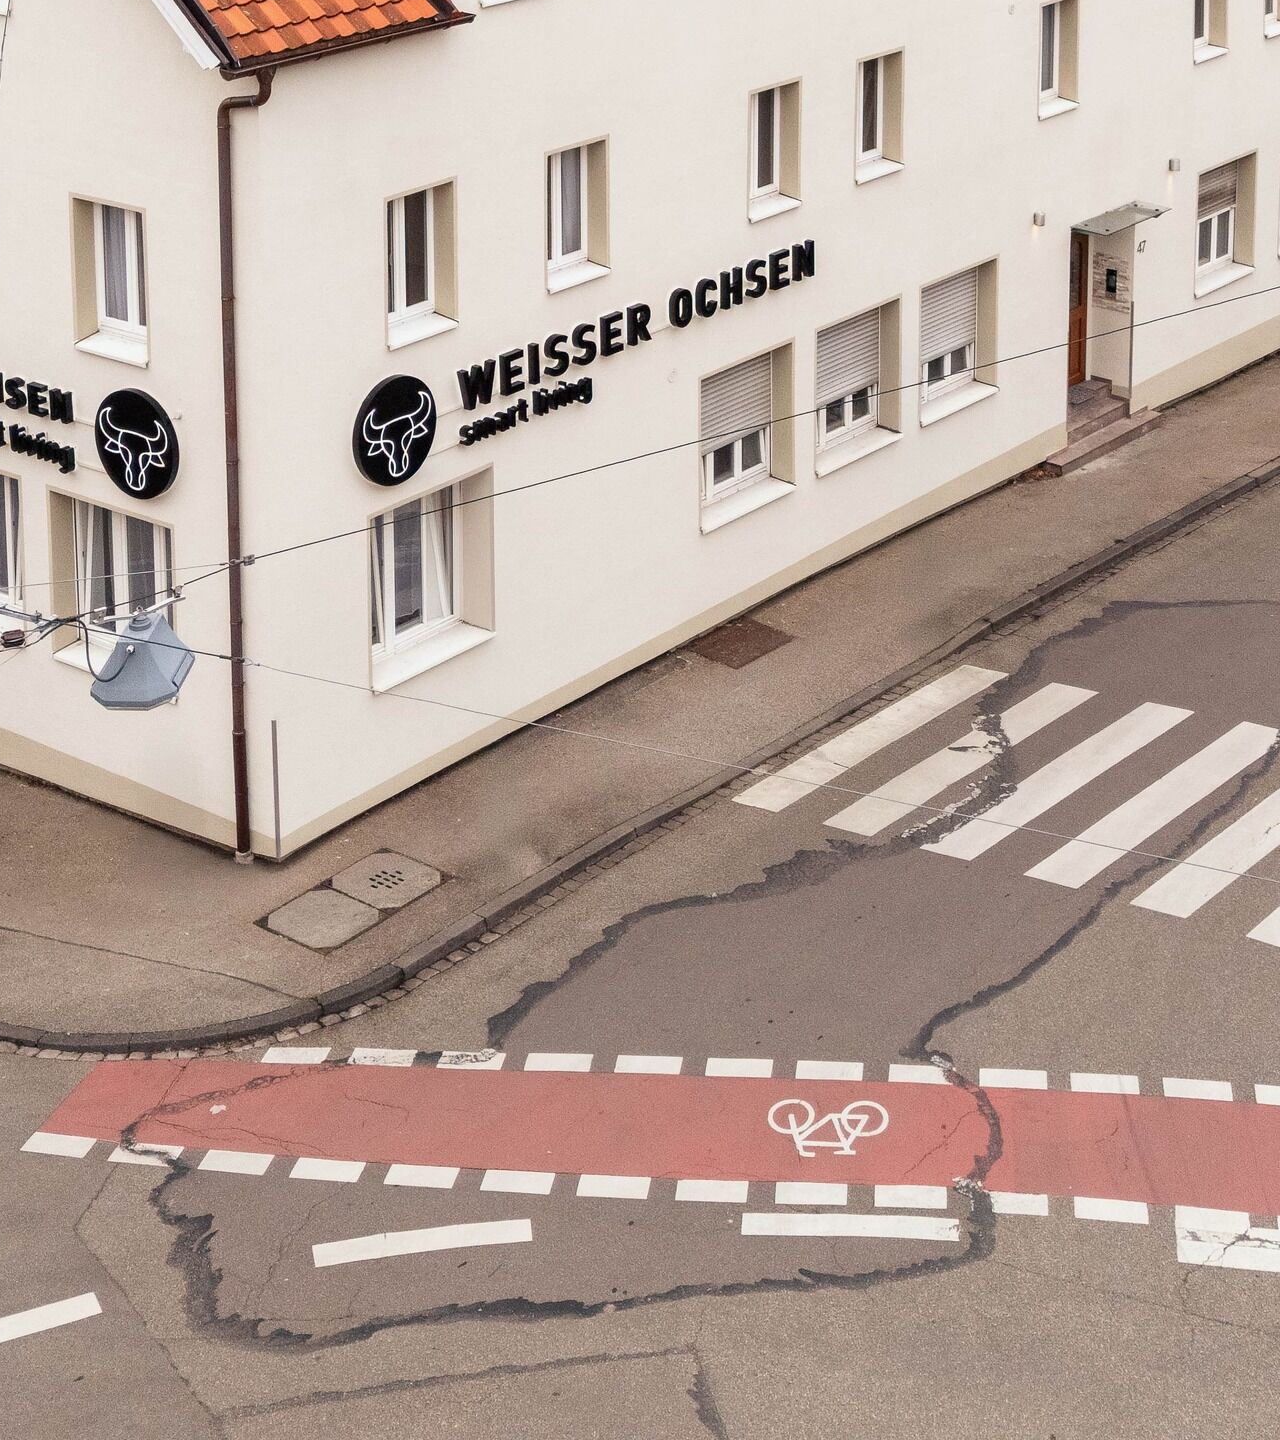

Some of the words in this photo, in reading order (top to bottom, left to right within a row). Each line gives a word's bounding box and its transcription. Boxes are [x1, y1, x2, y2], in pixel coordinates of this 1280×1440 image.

[1136, 239, 1147, 253] 47
[456, 301, 653, 411] WEISSER
[667, 239, 816, 329] OCHSEN
[458, 398, 529, 447] smart
[532, 376, 593, 416] living
[8, 423, 77, 474] living
